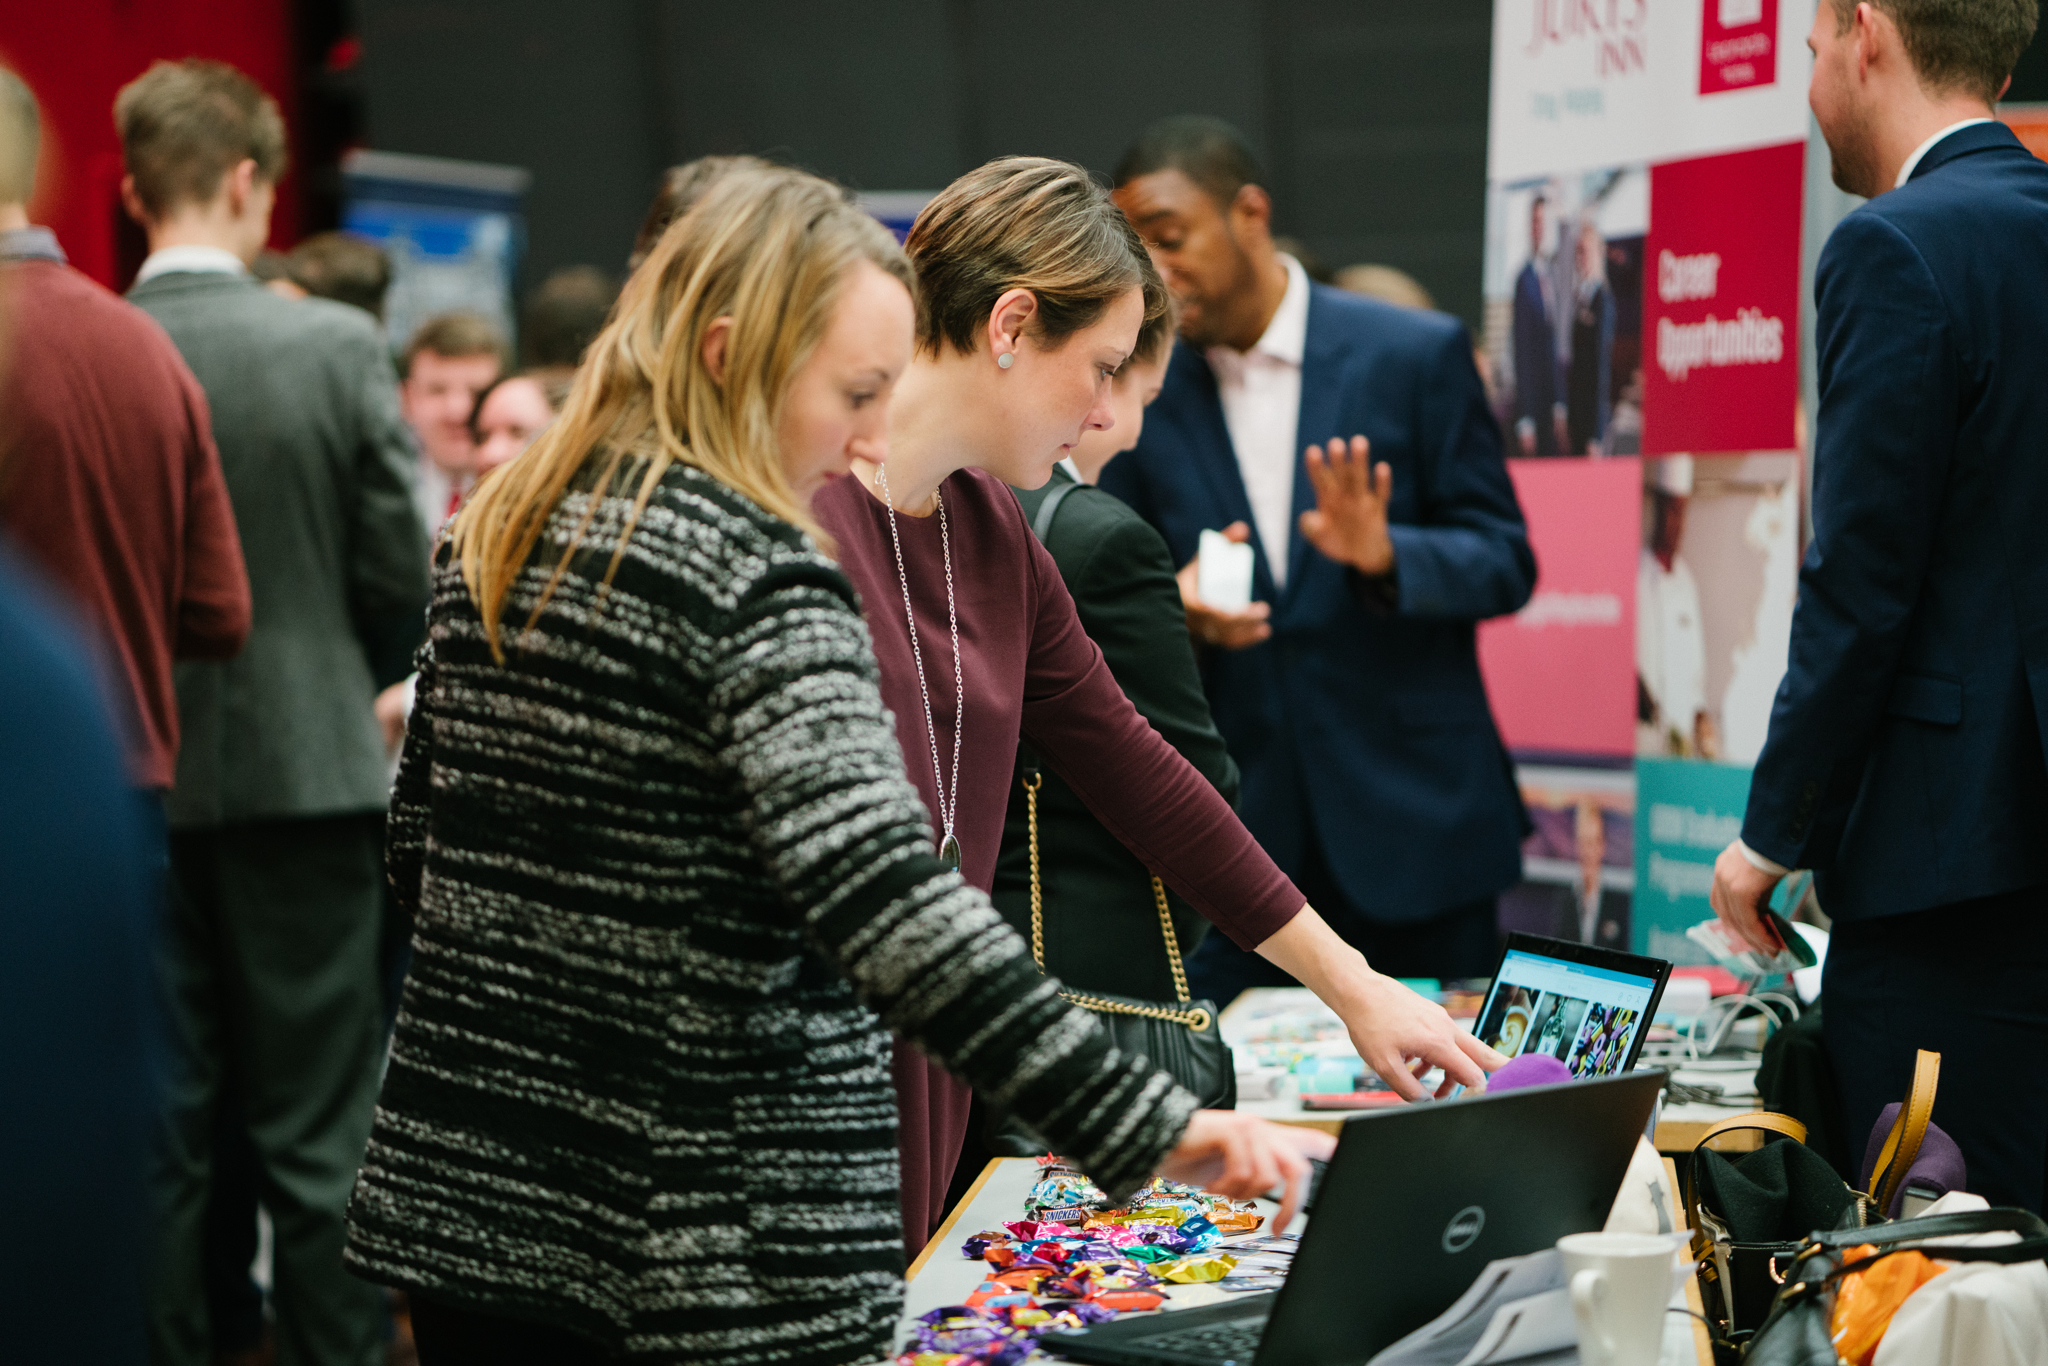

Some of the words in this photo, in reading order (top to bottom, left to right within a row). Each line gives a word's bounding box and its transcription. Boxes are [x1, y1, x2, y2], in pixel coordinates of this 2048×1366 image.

[1658, 249, 1721, 302] Career
[1657, 307, 1783, 383] Opportunities
[1044, 1209, 1081, 1221] SNICKERS
